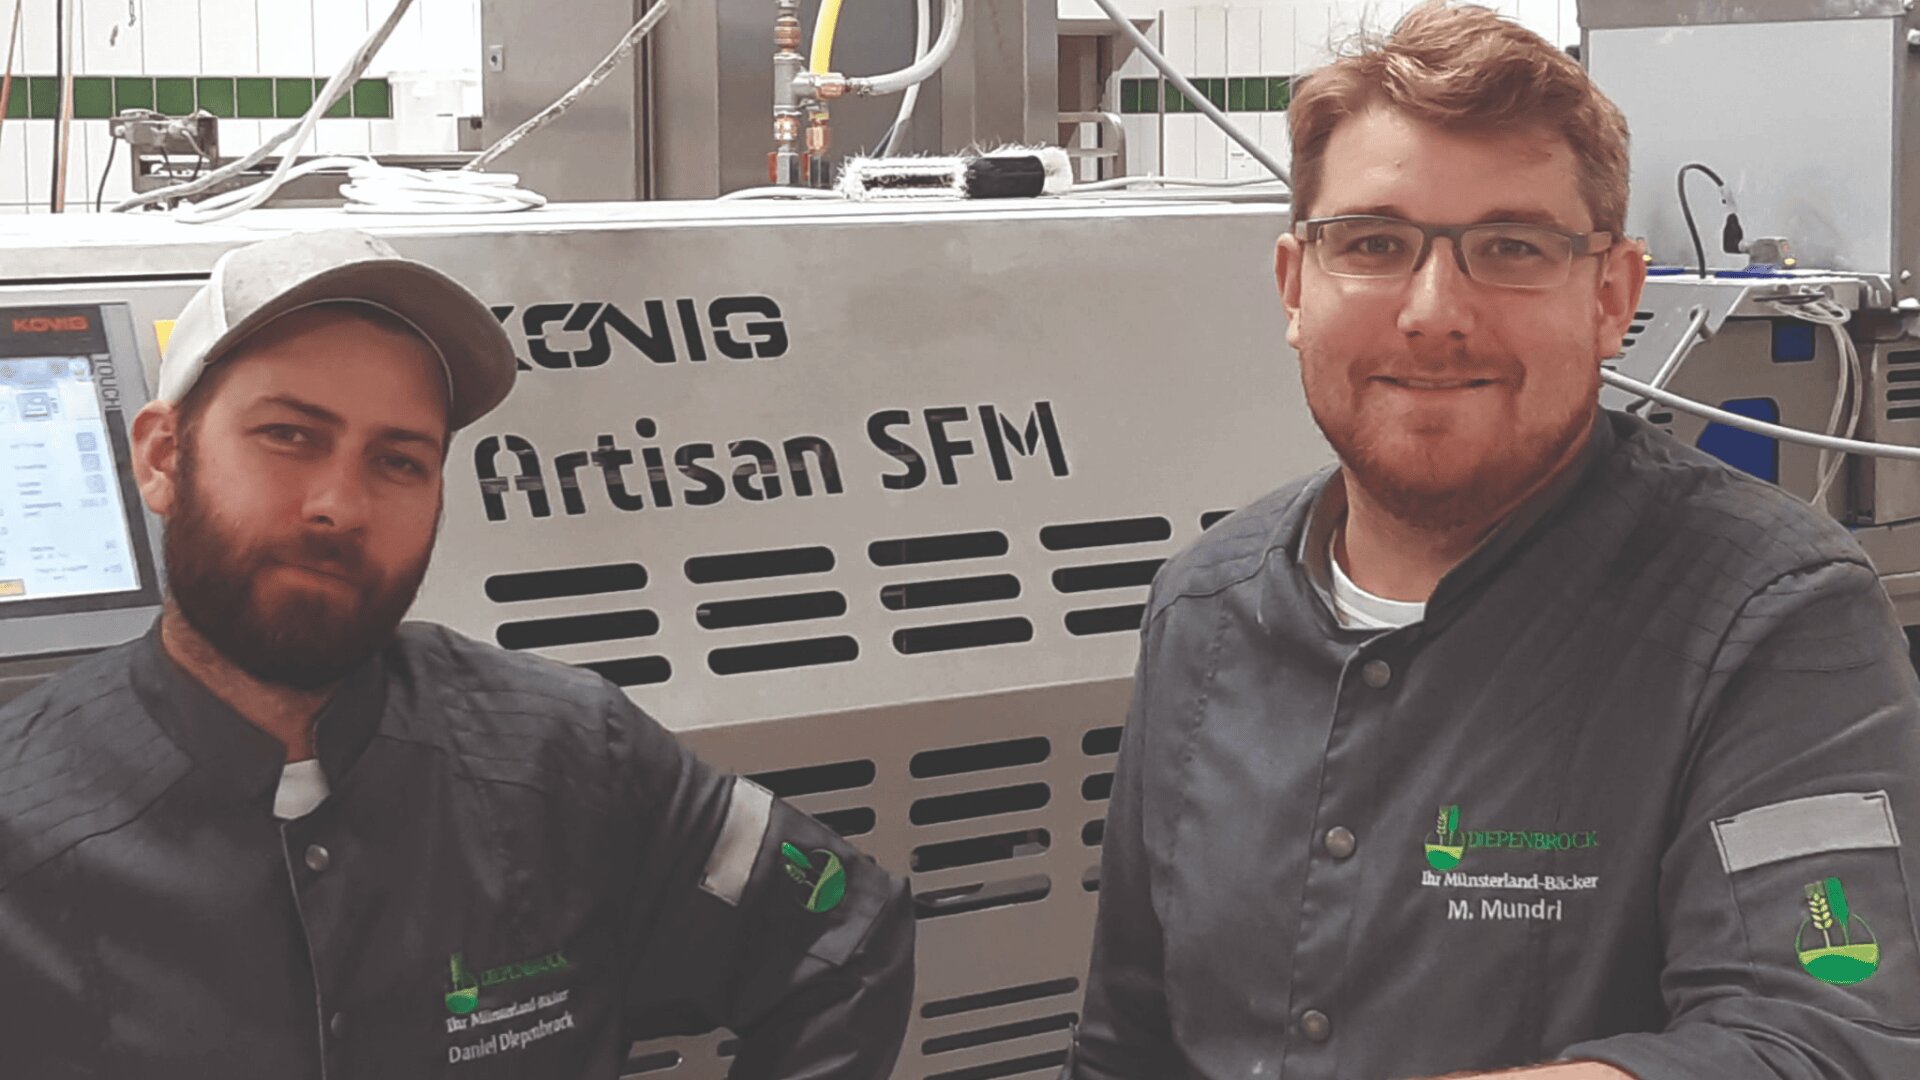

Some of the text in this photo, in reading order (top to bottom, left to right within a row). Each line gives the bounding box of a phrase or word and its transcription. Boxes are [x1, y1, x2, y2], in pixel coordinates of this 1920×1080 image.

[94, 355, 123, 411] TOUCH
[474, 401, 1070, 522] Artisan SFM
[1468, 830, 1599, 850] DIEPENBROCK
[1421, 870, 1442, 886] Ihr
[1448, 899, 1474, 920] M.
